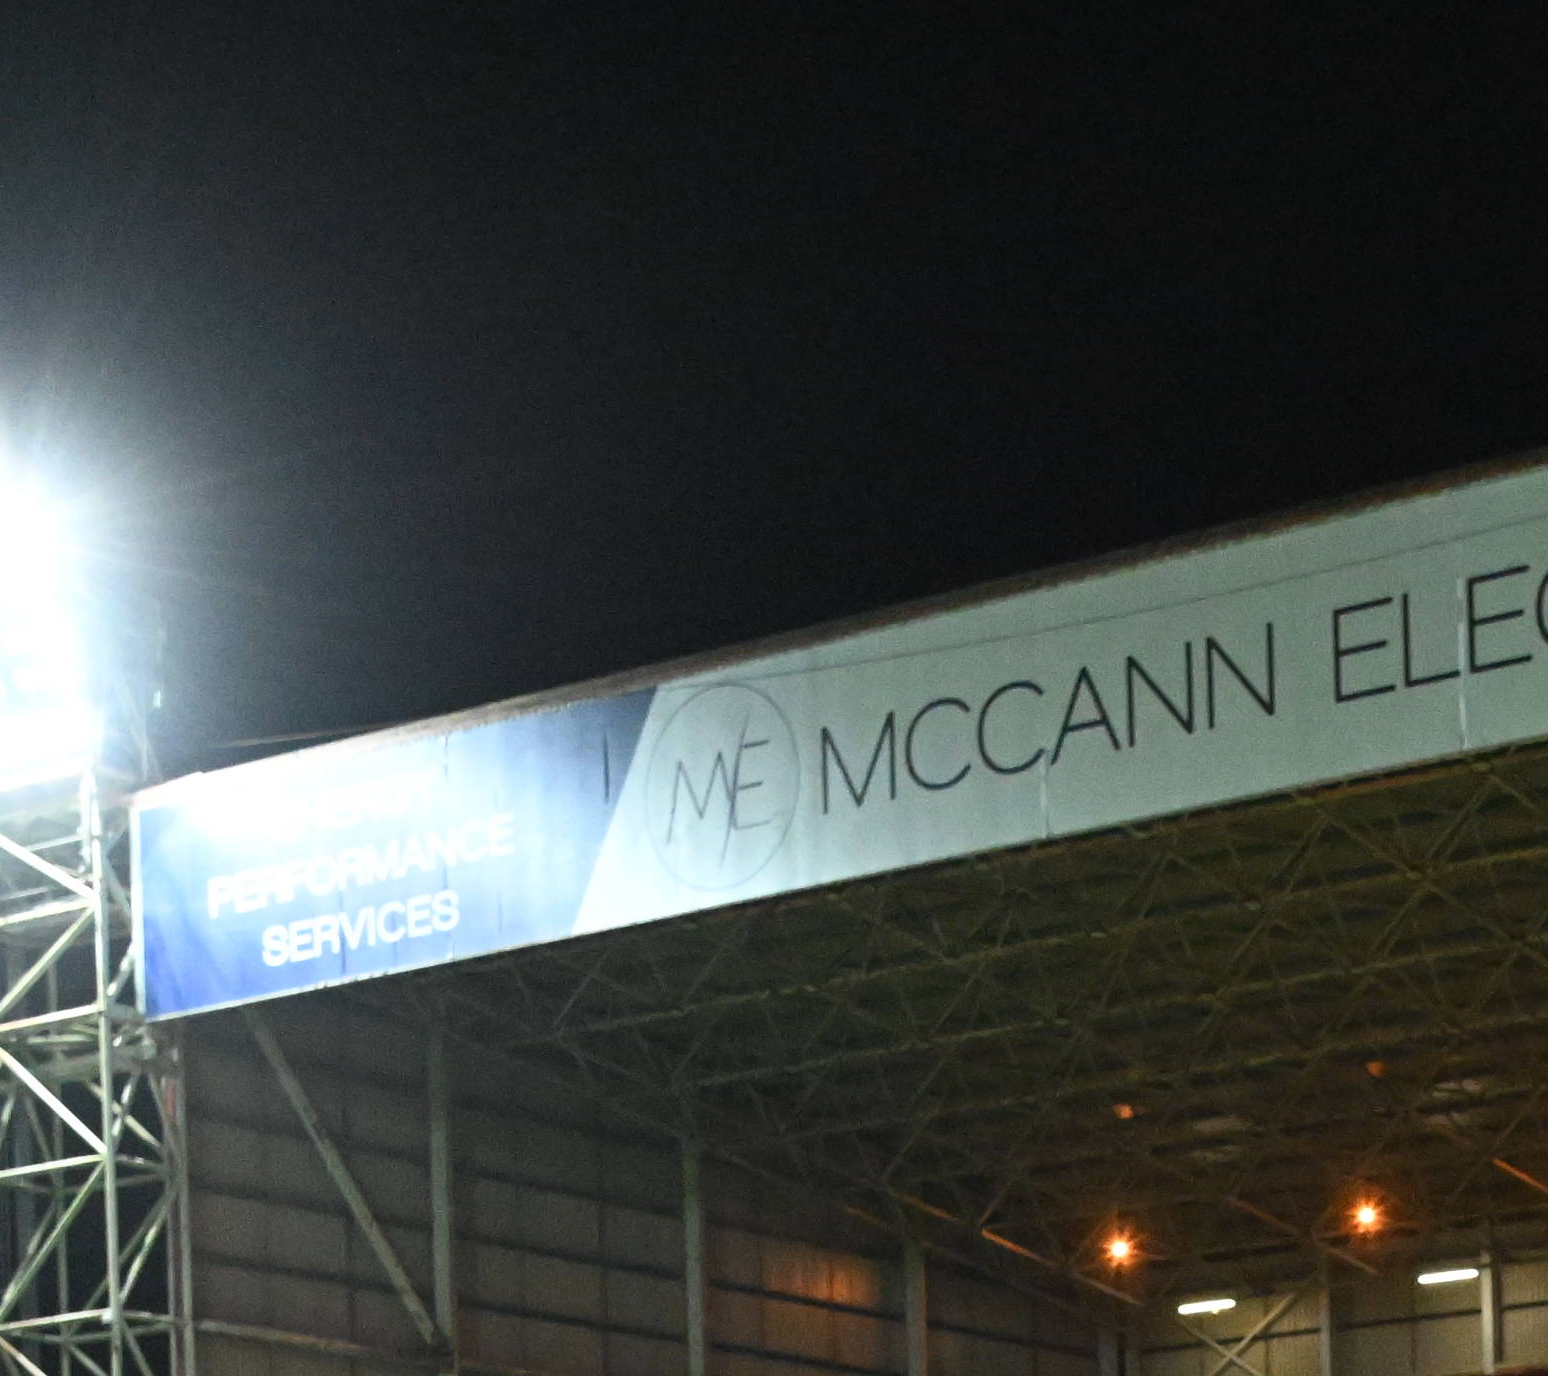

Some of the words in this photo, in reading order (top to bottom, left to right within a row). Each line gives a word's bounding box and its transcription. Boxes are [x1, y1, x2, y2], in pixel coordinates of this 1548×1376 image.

[819, 620, 1280, 815] MCCANN
[206, 813, 516, 919] PERFORMANCE
[261, 890, 460, 967] SERVICES
